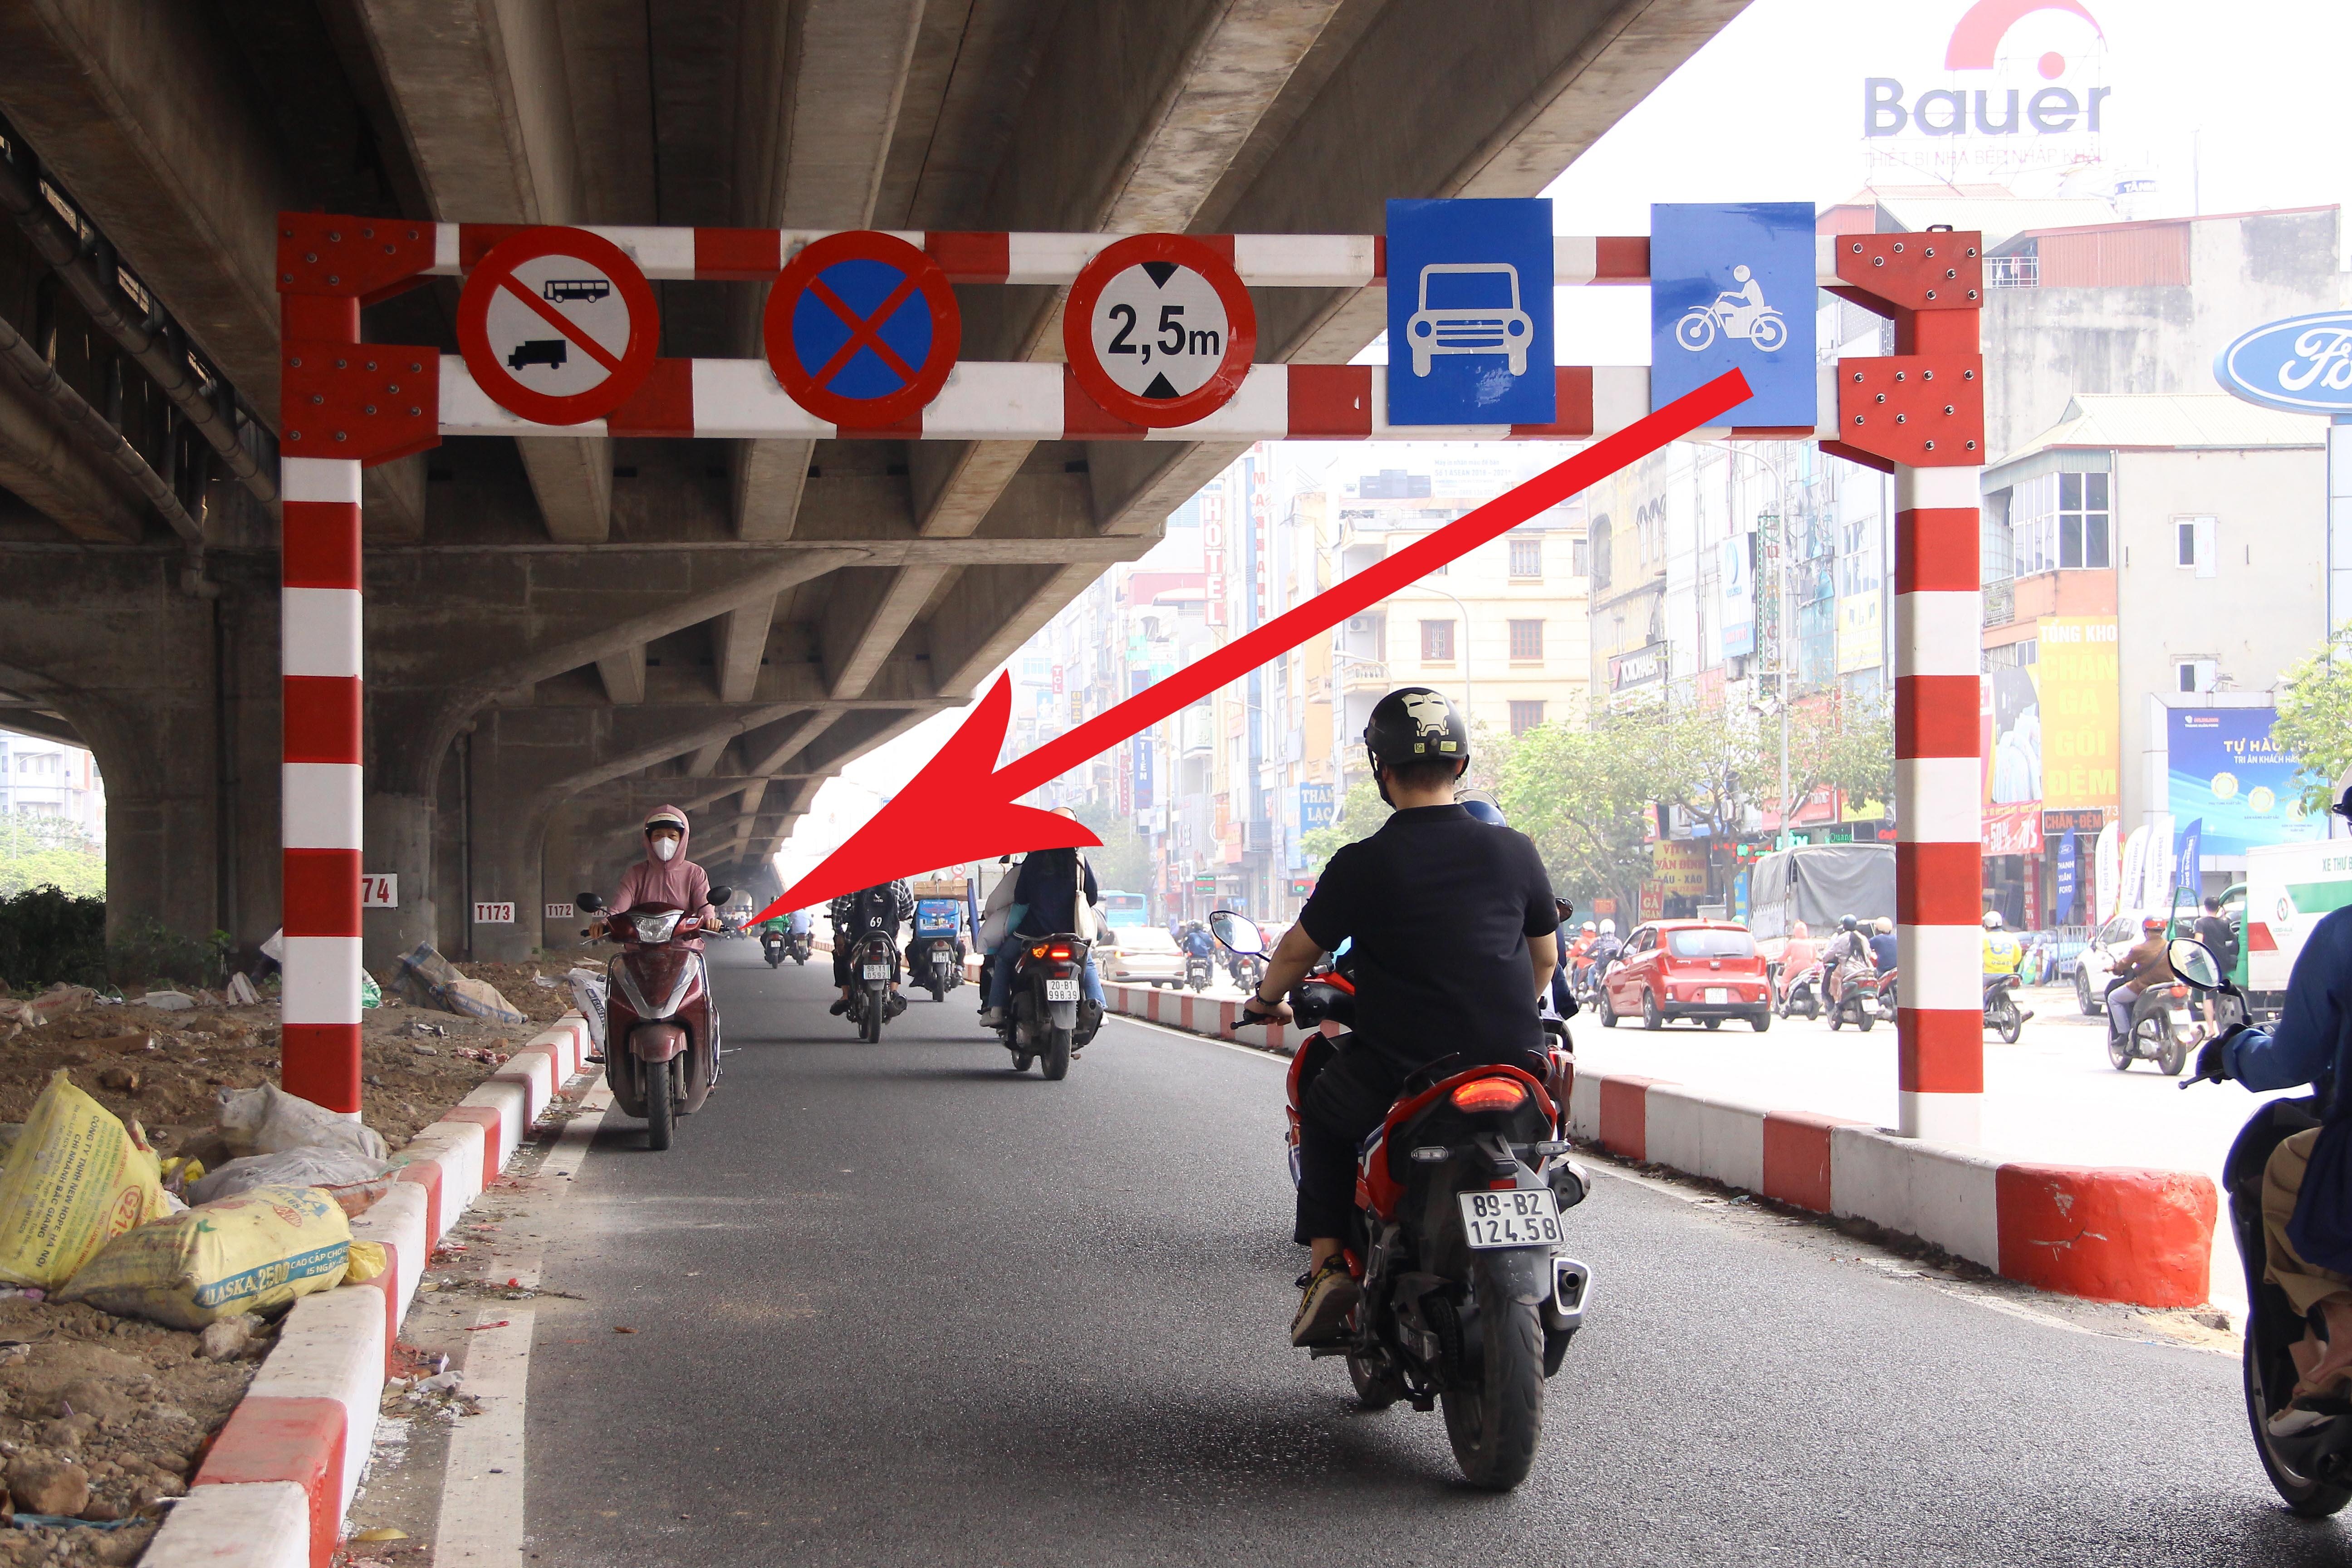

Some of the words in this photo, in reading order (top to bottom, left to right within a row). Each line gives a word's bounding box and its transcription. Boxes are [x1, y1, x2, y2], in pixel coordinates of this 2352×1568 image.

[1865, 78, 2111, 137] Bauer
[1108, 304, 1219, 365] 2,5m
[1253, 472, 1266, 618] MASSAGE
[1205, 497, 1222, 625] HOTEL
[2040, 621, 2081, 642] TỔNG
[2087, 624, 2117, 642] KHO
[1621, 652, 1658, 683] YOKOHAMA
[2041, 649, 2117, 681] CHĂN
[2058, 688, 2100, 715] GA
[2054, 720, 2106, 757] GỐI
[2224, 738, 2246, 754] TỰ
[2234, 755, 2245, 764] TRI
[2247, 754, 2258, 764] ÂN
[2259, 754, 2284, 764] KHÁCH
[2047, 765, 2117, 802] ĐỆM
[2058, 861, 2074, 869] THANH
[2323, 857, 2331, 872] XE
[2333, 855, 2347, 871] THƯ
[2058, 872, 2072, 882] XUÂN
[363, 878, 389, 903] 74
[2059, 885, 2072, 894] FORD
[477, 905, 510, 921] T173
[548, 905, 571, 916] T172
[870, 916, 882, 927] 69
[1049, 990, 1077, 999] 998.39
[1051, 981, 1073, 990] 20-B1
[85, 1115, 103, 1142] CÔNG
[71, 1133, 82, 1149] CHI
[81, 1142, 92, 1156] TY
[58, 1150, 77, 1184] NHÁNH
[72, 1156, 87, 1181] TNHH
[50, 1185, 66, 1206] BẮC
[64, 1182, 78, 1205] NEW
[1473, 1192, 1544, 1217] 89-B2
[36, 1205, 55, 1240] GIANG
[53, 1205, 69, 1232] HOPE
[1470, 1216, 1560, 1244] 124.58
[45, 1232, 59, 1249] HÀ
[34, 1248, 52, 1270] NỘI
[291, 1257, 307, 1269] CAO
[309, 1249, 326, 1263] CẤP
[327, 1247, 343, 1259] CHO
[259, 1261, 291, 1290] 2500
